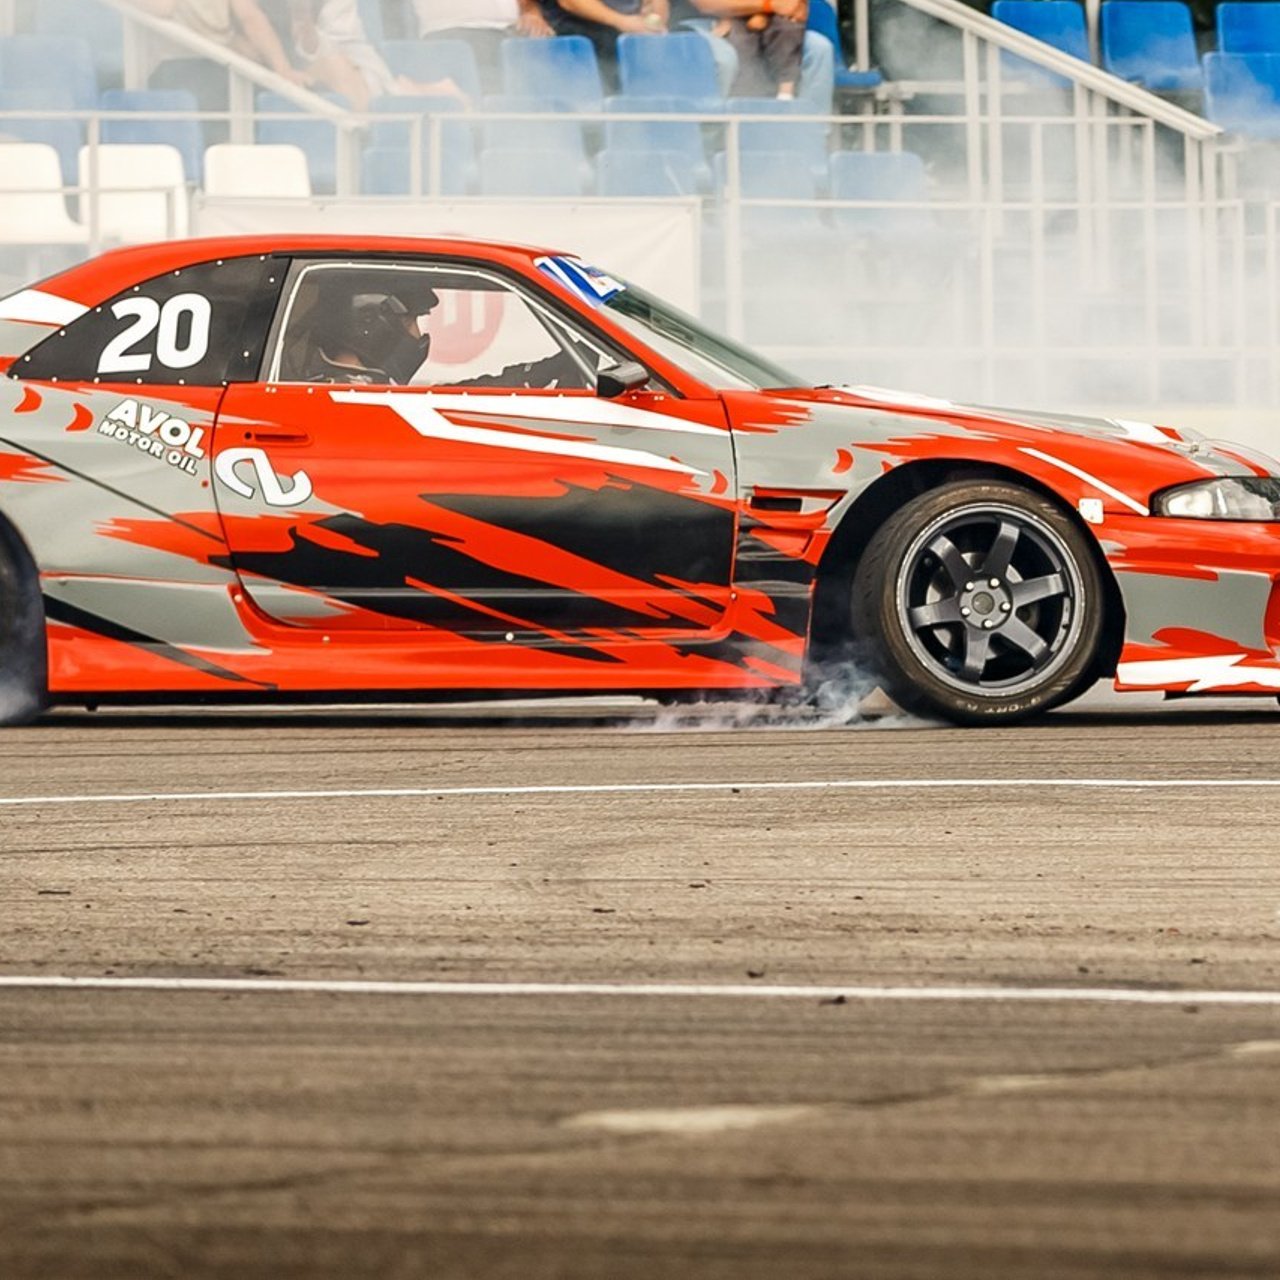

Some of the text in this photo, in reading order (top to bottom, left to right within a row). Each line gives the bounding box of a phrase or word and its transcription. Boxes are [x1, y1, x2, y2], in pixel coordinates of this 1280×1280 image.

[97, 292, 212, 374] 20
[98, 419, 198, 476] MOTOR OIL
[105, 398, 205, 459] AVOL
